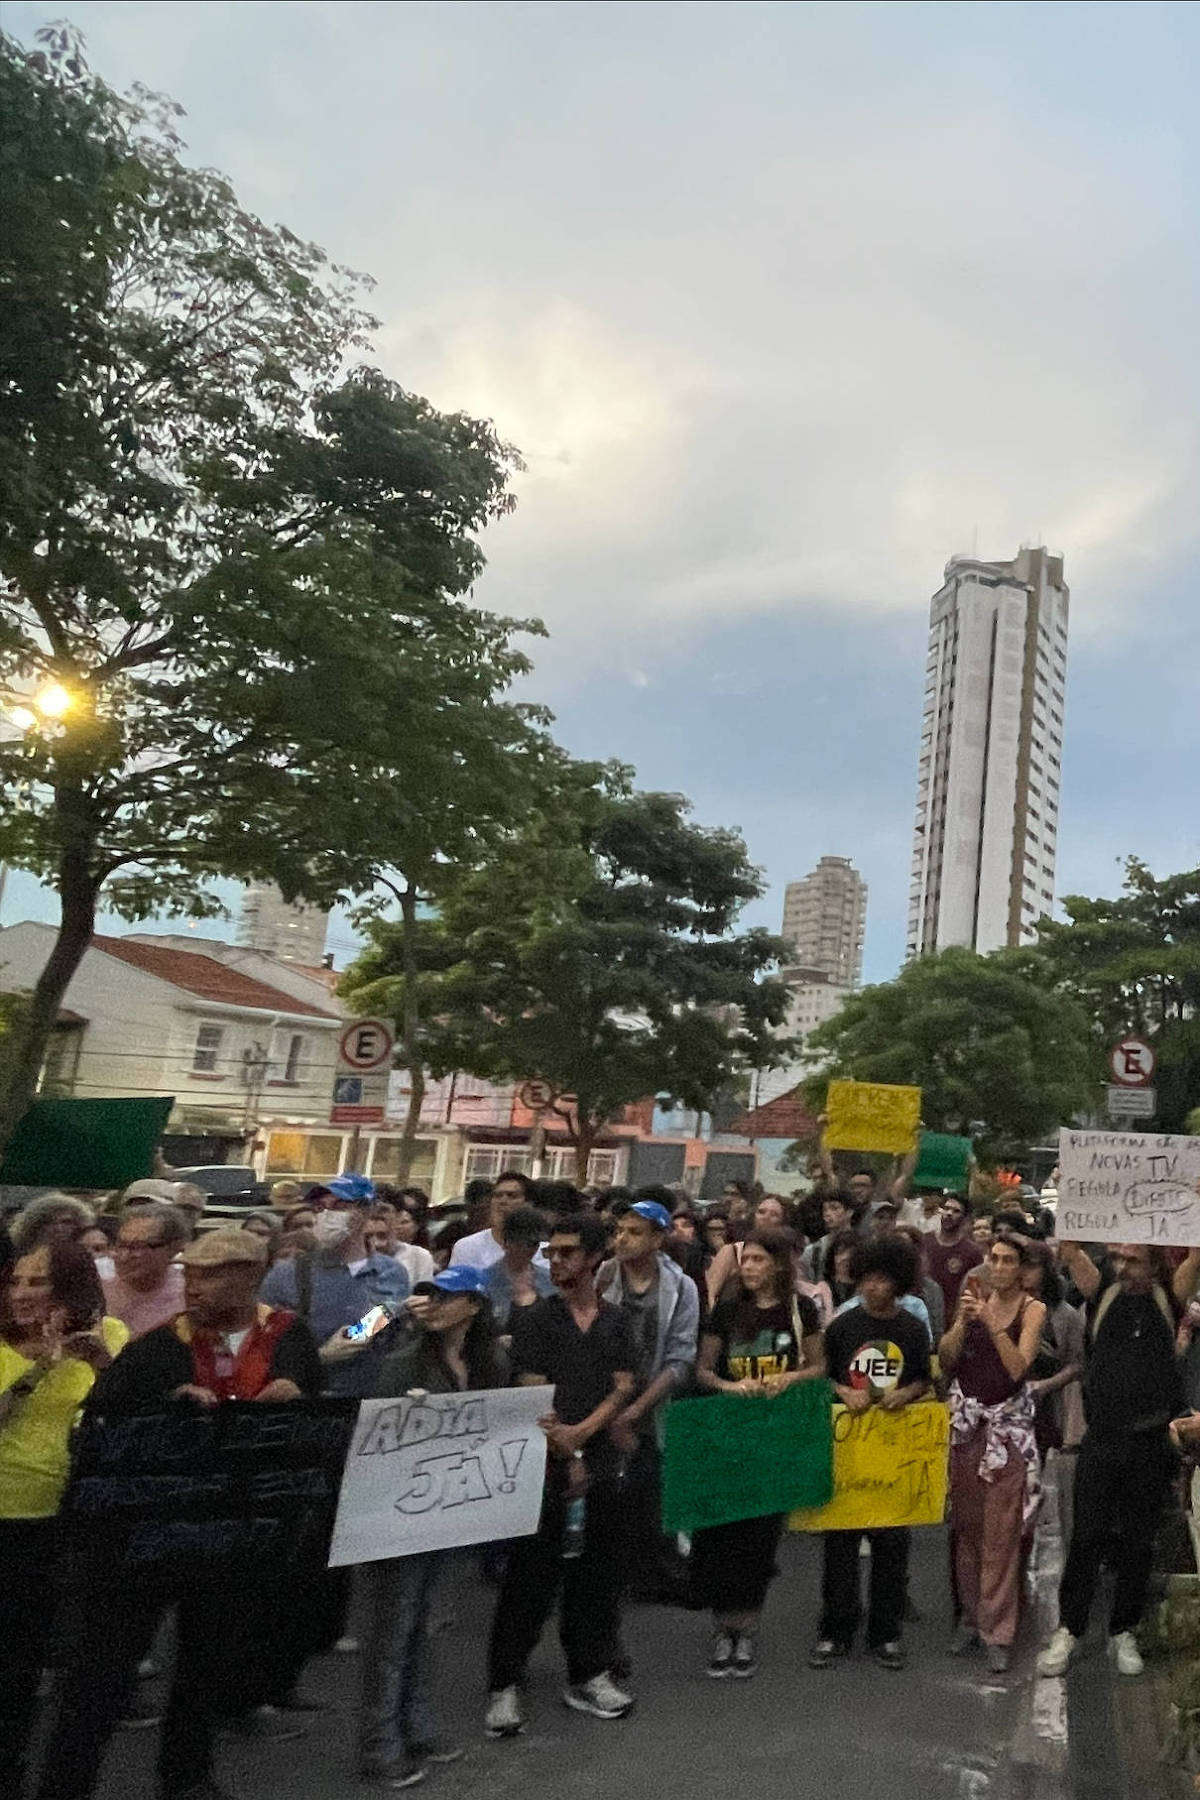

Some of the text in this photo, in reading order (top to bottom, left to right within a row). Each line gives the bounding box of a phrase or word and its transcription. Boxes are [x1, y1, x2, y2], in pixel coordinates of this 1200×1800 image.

[356, 1031, 376, 1059] E
[1125, 1049, 1142, 1074] E
[1089, 1152, 1142, 1171] NOVAS
